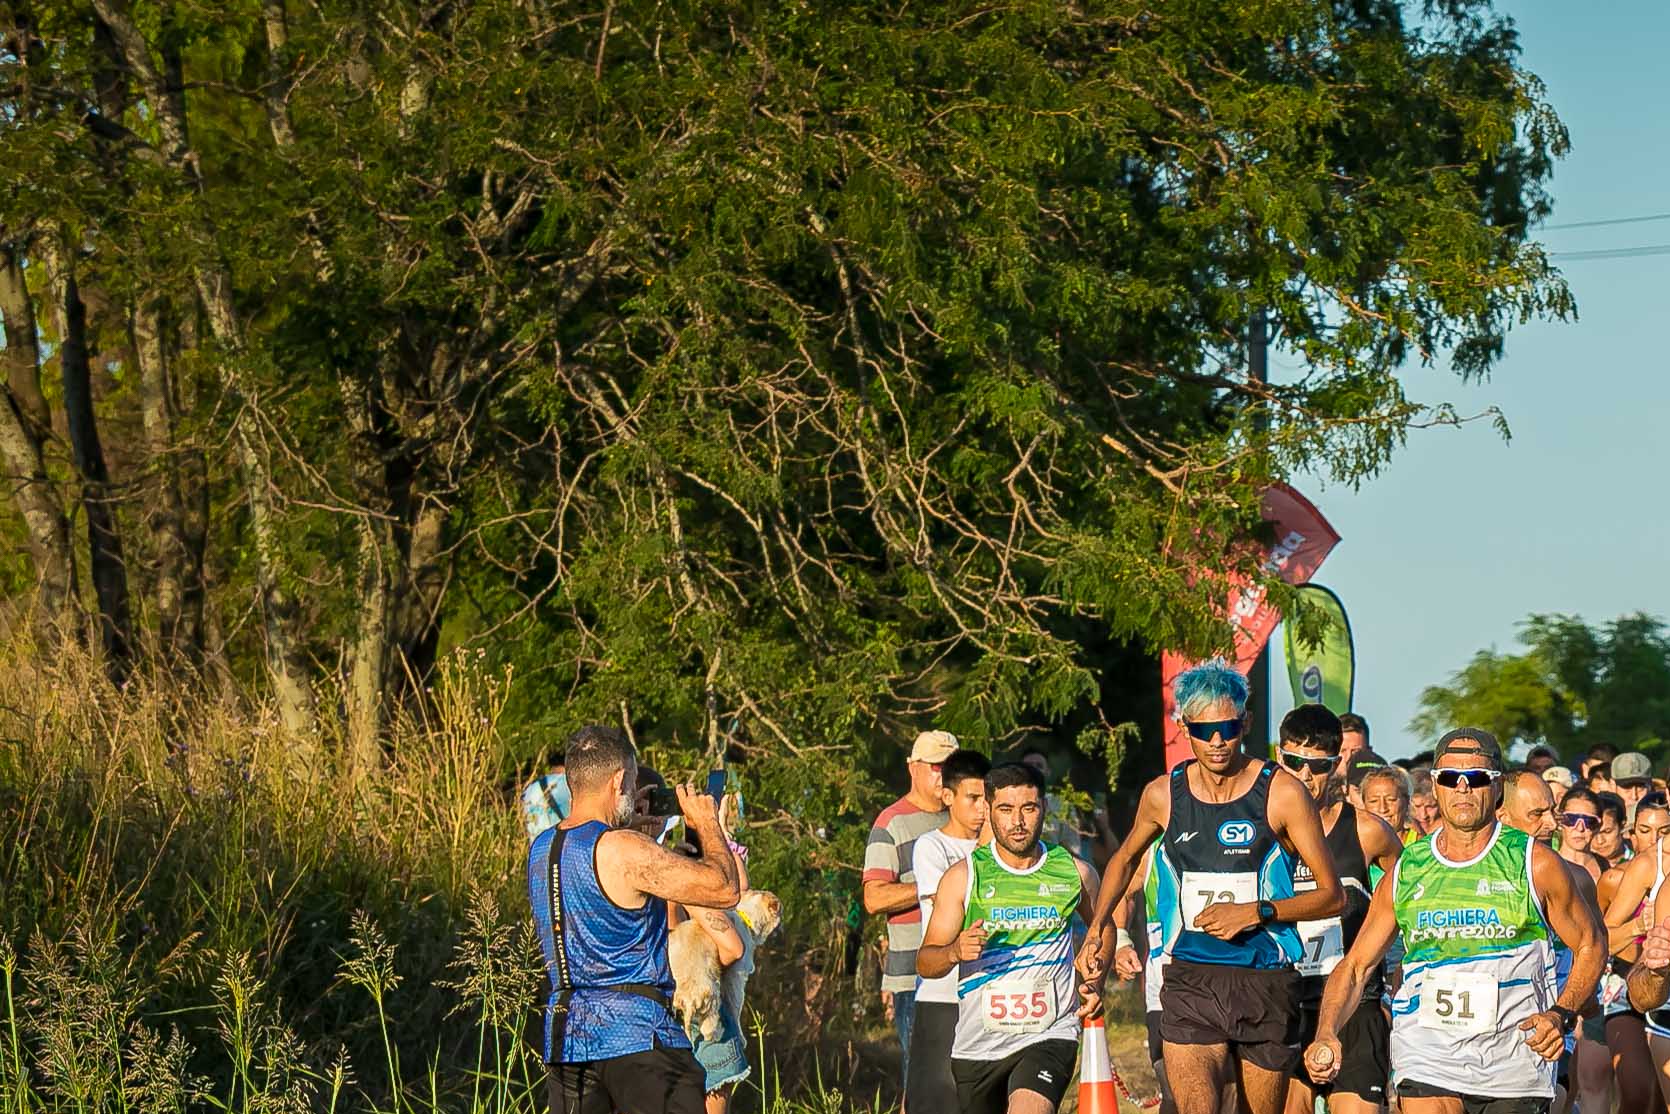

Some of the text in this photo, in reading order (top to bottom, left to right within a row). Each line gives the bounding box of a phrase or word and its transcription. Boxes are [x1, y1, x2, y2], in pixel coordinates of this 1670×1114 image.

[991, 905, 1059, 921] FIGHIERA
[1417, 908, 1500, 928] FIGHIERA
[990, 991, 1048, 1020] 535
[1435, 989, 1475, 1019] 51
